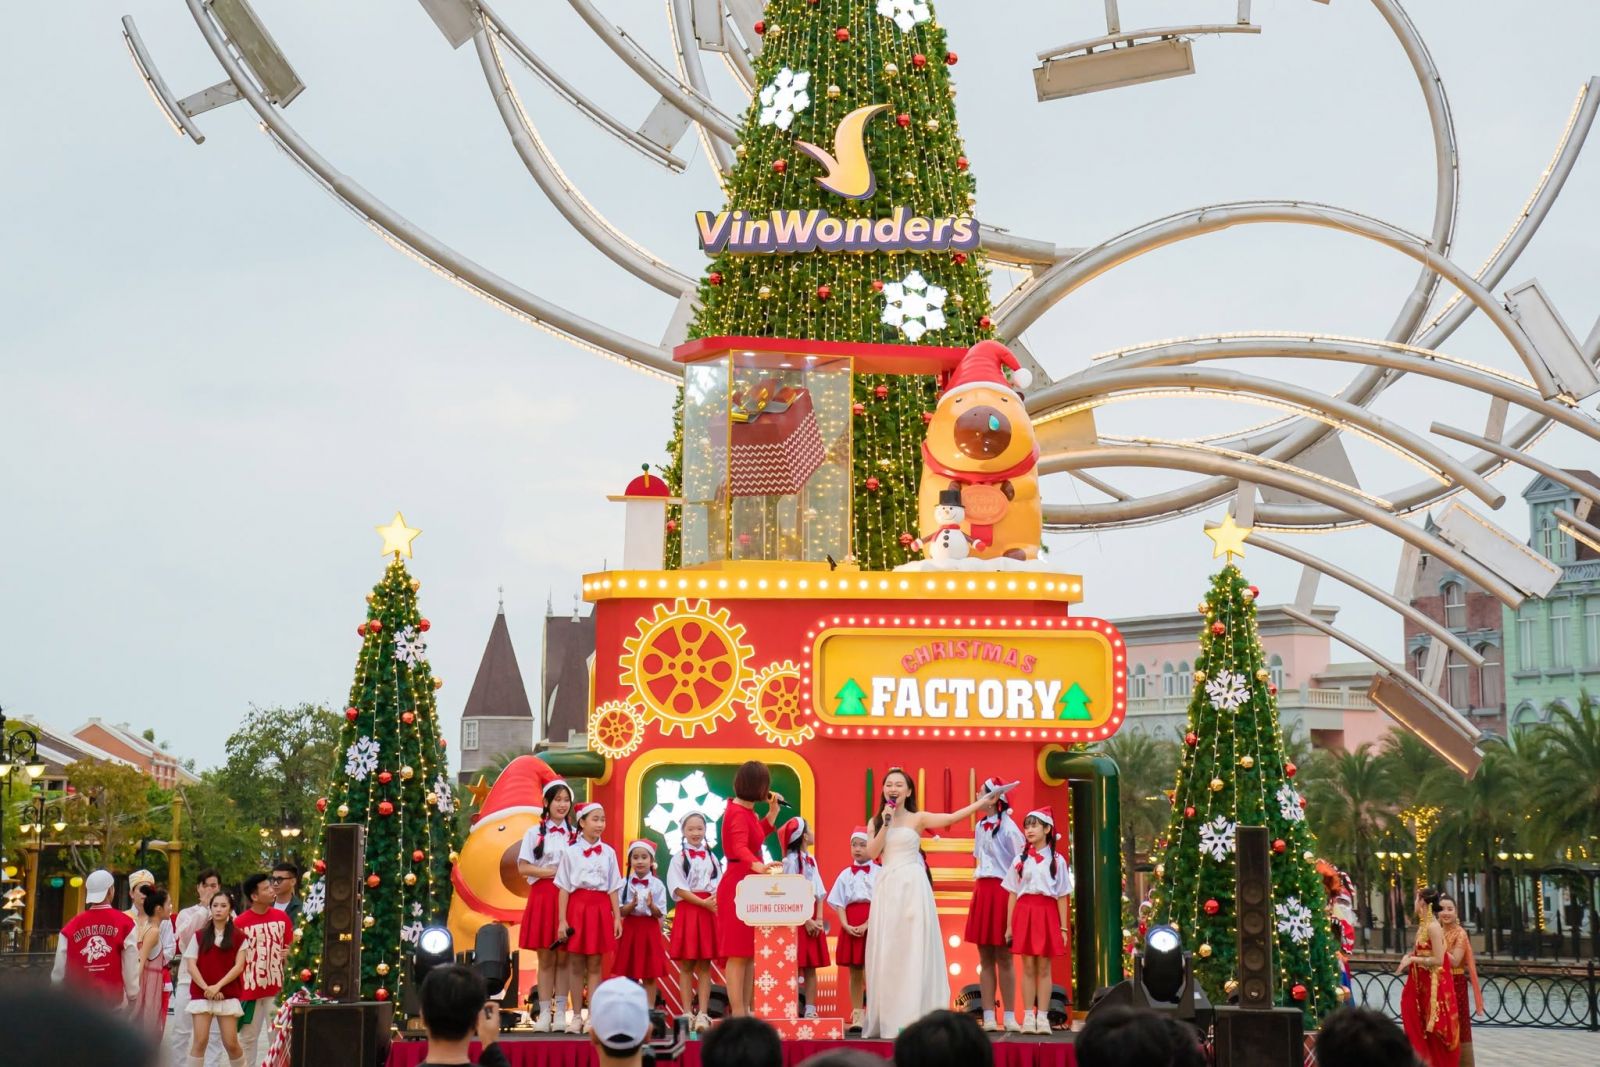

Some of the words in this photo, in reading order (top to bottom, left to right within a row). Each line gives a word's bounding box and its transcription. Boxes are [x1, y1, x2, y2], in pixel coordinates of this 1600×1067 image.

[695, 206, 976, 248] VinWonders
[901, 639, 1037, 674] CHRISTMAS
[871, 676, 1062, 720] FACTORY
[746, 903, 772, 913] LIGHTING
[773, 903, 804, 913] CEREMONY
